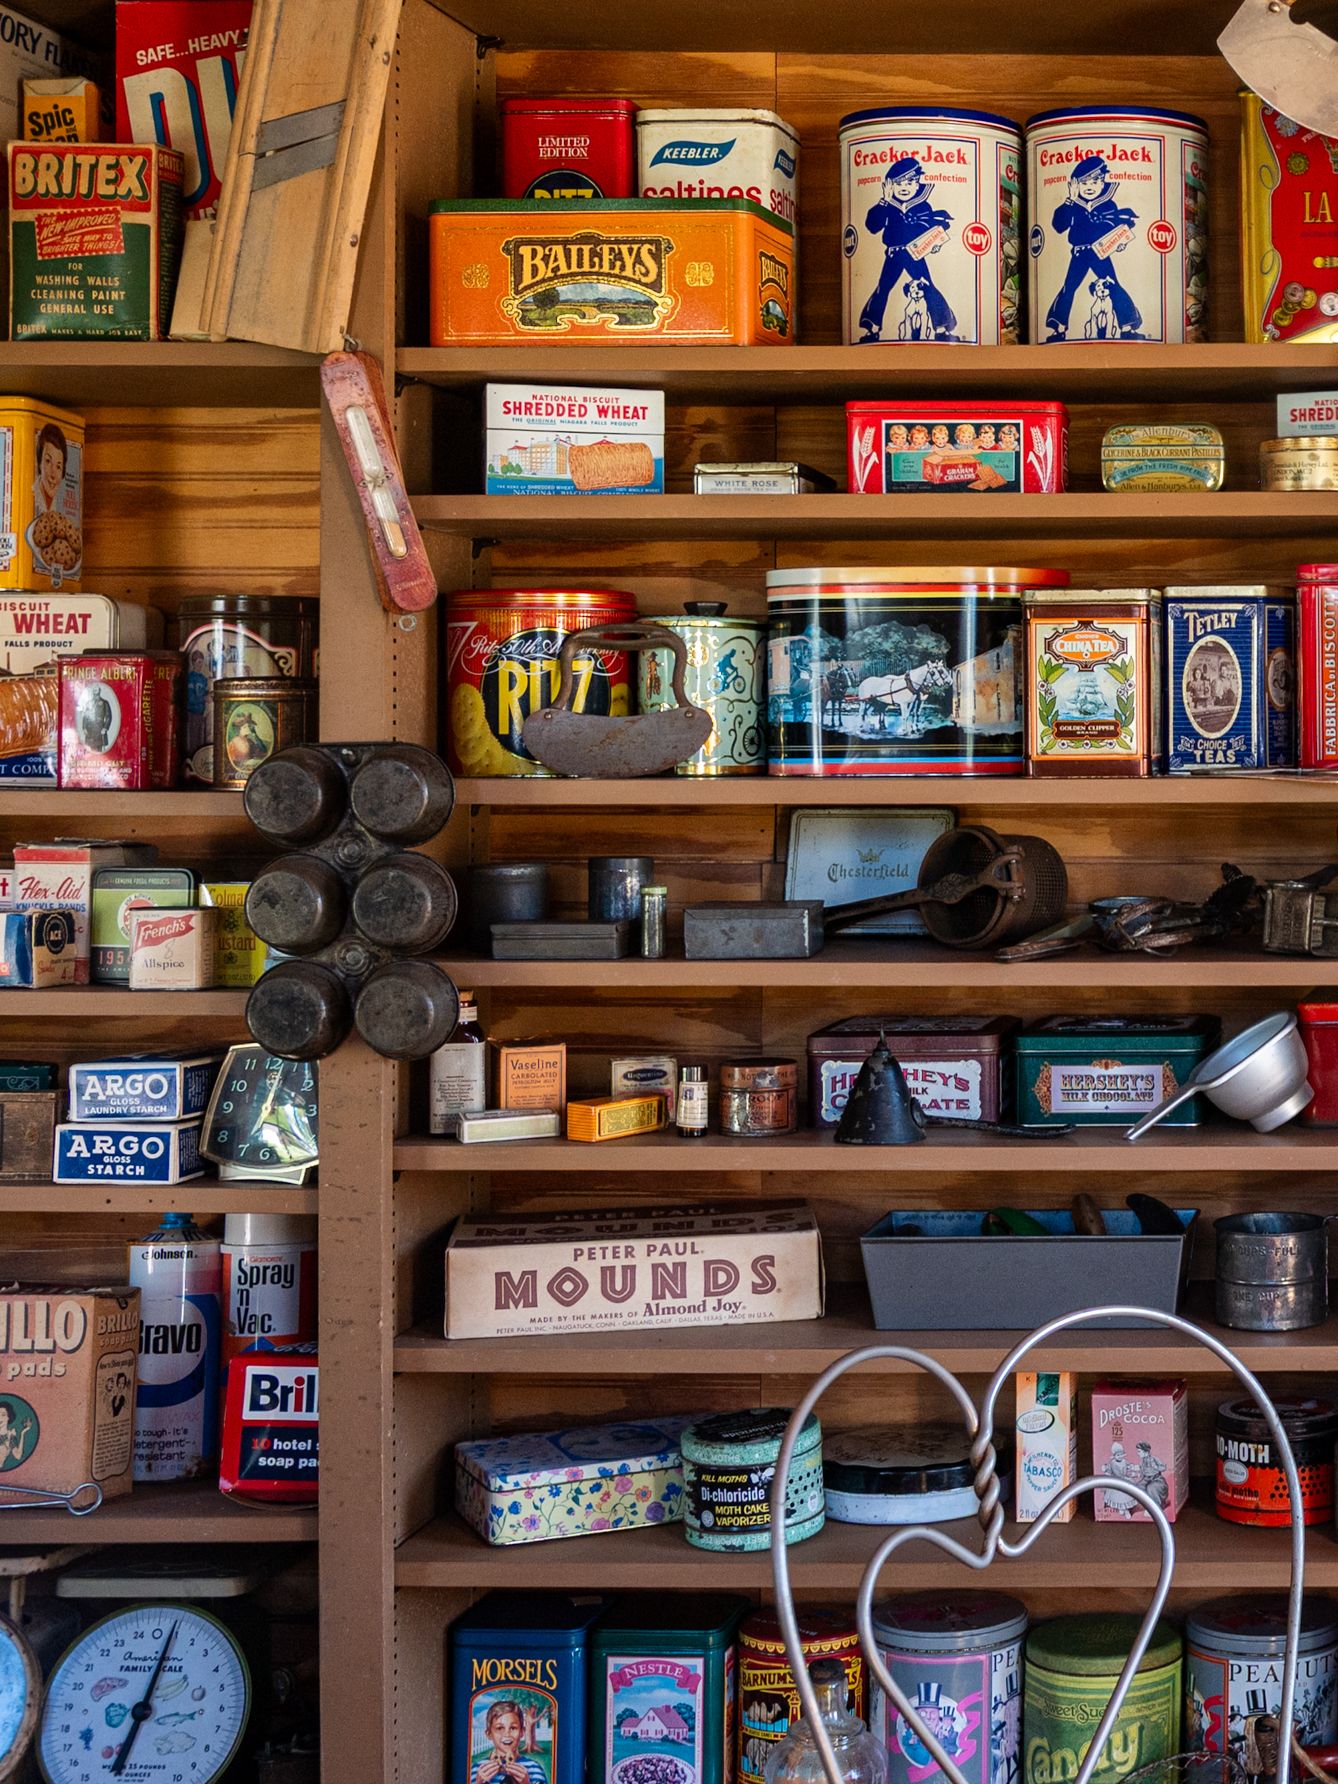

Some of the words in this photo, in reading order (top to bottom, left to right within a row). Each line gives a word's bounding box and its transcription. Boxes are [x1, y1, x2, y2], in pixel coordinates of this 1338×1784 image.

[0, 13, 42, 54] ORY
[28, 104, 75, 137] Spic
[537, 137, 590, 148] LIMITED
[539, 147, 588, 158] EDITION
[662, 147, 719, 160] KEEBLER
[15, 154, 149, 200] BRITEX
[857, 173, 881, 185] popcorn
[924, 173, 968, 184] confection
[1043, 174, 1067, 185] popcorn
[1109, 172, 1152, 182] confection
[1304, 191, 1334, 223] LA
[965, 229, 989, 250] toy
[1151, 228, 1175, 250] toy
[68, 262, 83, 270] FOR
[518, 239, 659, 288] BAILEYS
[760, 254, 788, 287] BAILEYS
[35, 275, 80, 286] WASHING
[87, 276, 120, 287] WALLS
[31, 289, 84, 300] CLEANING
[92, 291, 126, 301] PAINT
[40, 304, 87, 315] GENERAL
[93, 305, 114, 315] USE
[532, 394, 578, 402] NATIONAL
[583, 396, 620, 404] BISCUIT
[502, 400, 588, 418] SHREDDED
[596, 405, 649, 420] WHEAT
[714, 479, 747, 487] WHITE
[752, 479, 779, 487] ROSE
[13, 613, 92, 634] WHEAT
[1183, 612, 1238, 643] TETLEY
[34, 640, 73, 648] PRODUCT
[1093, 640, 1114, 652] TEA
[143, 680, 154, 733] CIGARETTE
[1325, 681, 1337, 756] FABBRICA
[1197, 739, 1227, 750] CHOICE
[1194, 750, 1236, 763] TEAS
[828, 863, 909, 882] Chesterfield
[19, 875, 86, 900] Flex-Aid
[50, 931, 62, 941] ACE
[140, 918, 187, 941] French's
[143, 958, 185, 970] Allspice
[511, 1059, 558, 1070] Vaseline
[511, 1072, 558, 1080] CARBOLATED
[831, 1066, 970, 1094] HEHEY'S
[82, 1074, 169, 1100] ARGO
[231, 1080, 247, 1092] 10
[1061, 1073, 1155, 1093] HERSHEY'S
[1061, 1091, 1088, 1102] MILK
[1091, 1091, 1154, 1102] CHOCOLATE
[85, 1105, 129, 1114] LAUNDRY
[130, 1105, 167, 1113] STARCH
[223, 1101, 233, 1113] 9
[217, 1130, 228, 1142] 8
[67, 1135, 165, 1159] ARGO
[103, 1155, 131, 1163] GLOSS
[260, 1148, 270, 1160] 6
[87, 1165, 145, 1176] STARCH
[141, 1248, 195, 1260] Johnson
[573, 1246, 636, 1262] PETER
[646, 1241, 701, 1257] PAUL
[237, 1257, 295, 1288] Spray
[494, 1254, 777, 1311] MOUNDS
[529, 1316, 553, 1324] MADE
[572, 1313, 586, 1321] THE
[590, 1312, 624, 1321] MAKERS
[643, 1302, 708, 1319] Almond
[712, 1298, 743, 1316] Joy
[98, 1312, 138, 1336] BRILLO
[236, 1307, 273, 1334] Vac
[7, 1357, 67, 1381] pads
[249, 1372, 318, 1413] Bril
[1100, 1400, 1152, 1427] DROSTE'S
[1124, 1414, 1165, 1424] COCOA
[251, 1438, 270, 1449] 10
[273, 1438, 312, 1450] hotel
[258, 1456, 294, 1470] soap
[1023, 1462, 1062, 1478] TABASCO
[701, 1474, 716, 1483] KILL
[717, 1474, 748, 1484] MOTHS
[701, 1486, 766, 1503] Di-chloricide
[715, 1504, 741, 1515] MOTH
[743, 1502, 770, 1514] CAKE
[716, 1513, 772, 1526] VAPORIZER
[114, 1638, 125, 1648] 23
[100, 1648, 111, 1658] 22
[119, 1665, 153, 1673] FAMILY
[472, 1658, 557, 1692] MORSELS
[172, 1773, 183, 1783] 10
